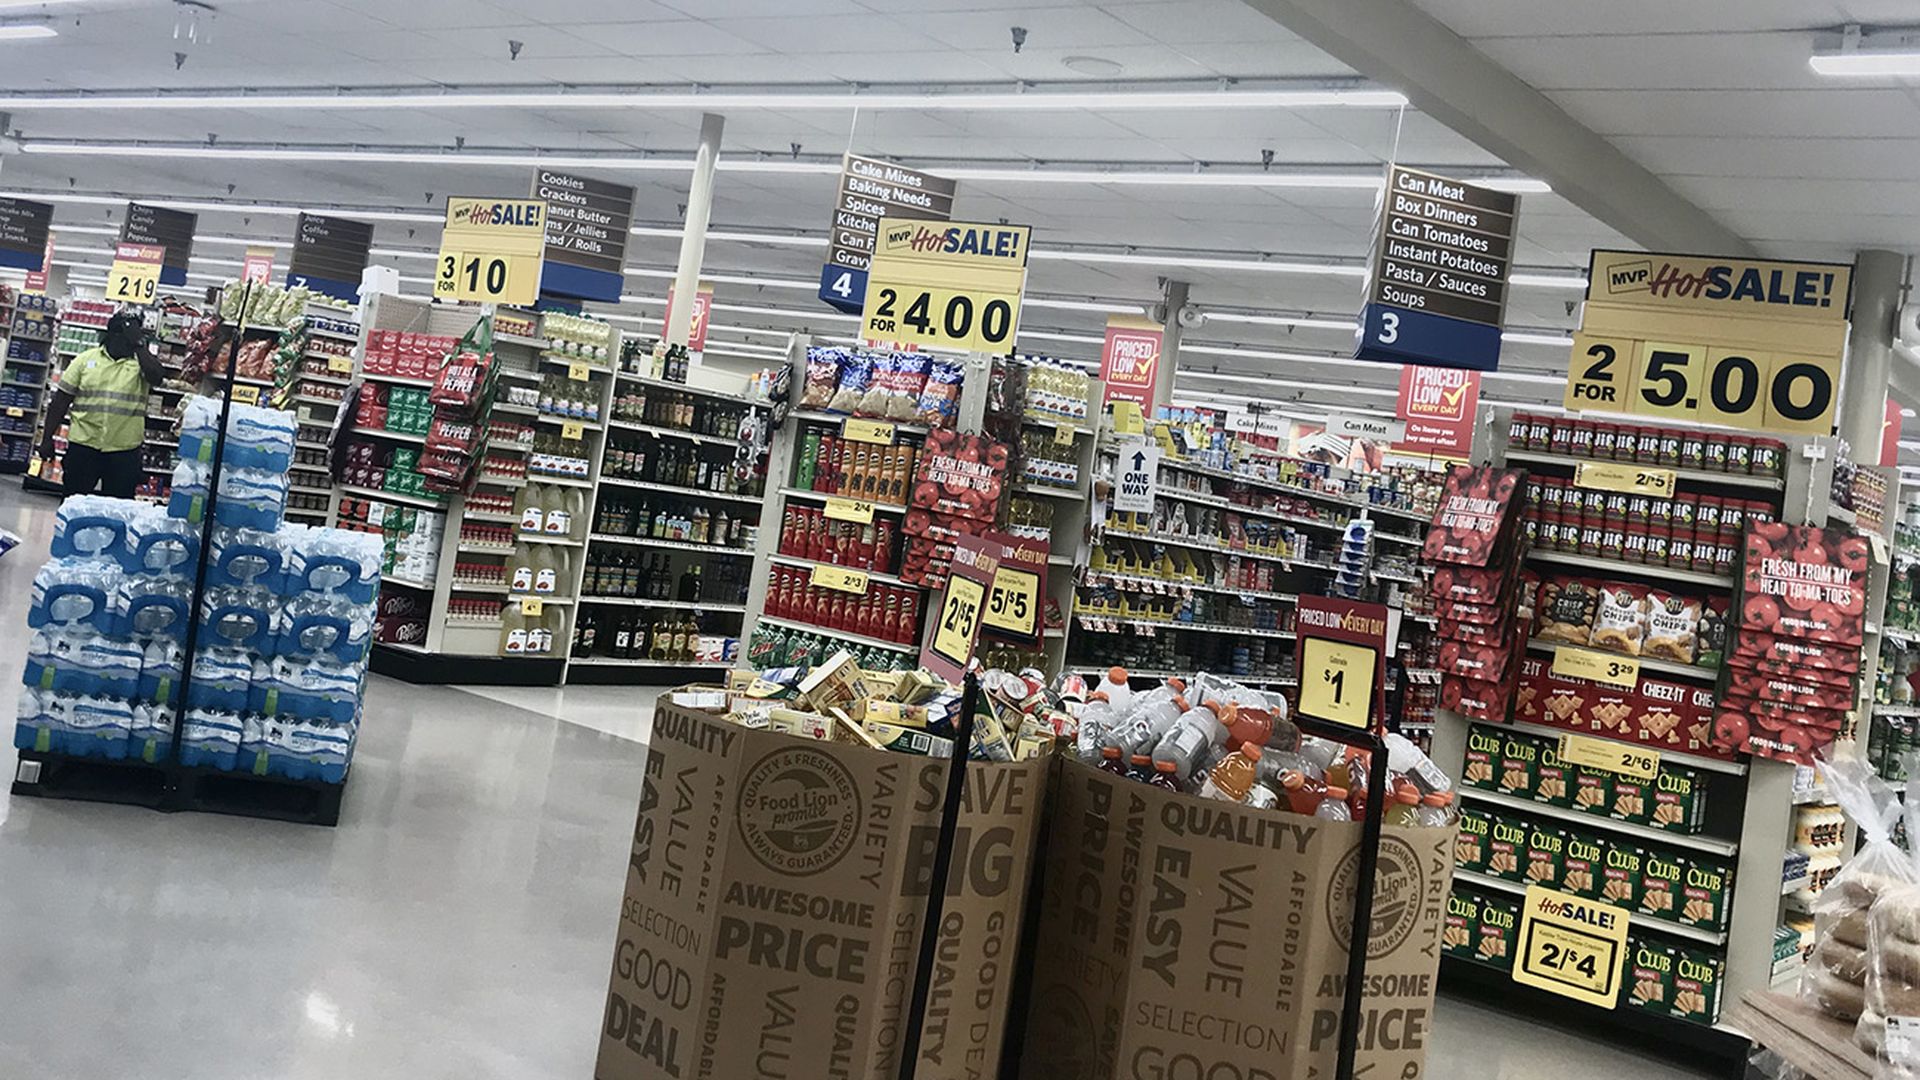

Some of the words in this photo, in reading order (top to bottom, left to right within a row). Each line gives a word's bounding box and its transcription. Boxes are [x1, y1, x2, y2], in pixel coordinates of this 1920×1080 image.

[541, 172, 584, 190] Cookies
[852, 160, 883, 179] Cake
[885, 168, 922, 187] Mixes
[539, 188, 587, 205] Crackers
[849, 178, 891, 201] Baking
[893, 189, 932, 208] Needs
[1398, 174, 1425, 193] Can
[1428, 179, 1465, 201] Meat
[576, 208, 611, 225] Butter
[845, 196, 886, 216] Spices
[1395, 195, 1420, 215] Box
[1424, 202, 1478, 227] Dinners
[129, 223, 147, 232] Nuts
[131, 214, 155, 225] Candy
[302, 225, 329, 236] Coffee
[573, 223, 608, 240] Jellies
[127, 232, 157, 243] Popcorn
[301, 234, 316, 244] Tea
[575, 236, 602, 253] Rolls
[840, 231, 861, 248] Can
[889, 231, 911, 243] MVP
[1391, 218, 1419, 238] Can
[1423, 223, 1488, 252] Tomatoes
[836, 250, 871, 271] Gravy
[1389, 240, 1437, 265] Instant
[1440, 250, 1498, 277] Potatoes
[438, 281, 456, 292] FOR
[442, 255, 456, 279] 3
[465, 257, 507, 294] 10
[832, 272, 852, 298] 4
[1385, 262, 1425, 285] Pasta
[1425, 271, 1437, 287] /
[1439, 273, 1487, 297] Sauces
[1612, 269, 1648, 286] MVP
[1383, 286, 1425, 309] Soups
[870, 319, 896, 333] FOR
[876, 288, 898, 317] 2
[903, 292, 1012, 343] 4.00
[1378, 312, 1399, 344] 3
[1115, 340, 1152, 359] PRICED
[448, 365, 461, 376] HOT
[1111, 372, 1131, 381] EVERY
[1132, 375, 1148, 383] DAY
[1112, 357, 1136, 373] LOW
[1416, 367, 1463, 388] PRICED
[441, 379, 475, 393] PEPPER
[1414, 385, 1442, 404] LOW
[1573, 383, 1616, 402] FOR
[1582, 344, 1617, 382] 2
[1640, 350, 1833, 421] 5.00
[1412, 403, 1438, 413] EVERY
[1439, 405, 1458, 415] DAY
[440, 423, 472, 440] PEPPER
[1236, 418, 1254, 430] Cake
[1257, 420, 1278, 432] Mixes
[1344, 420, 1360, 431] Can
[1362, 421, 1387, 435] Meat
[1406, 433, 1418, 443] buy
[1419, 435, 1435, 443] most
[1411, 424, 1421, 432] On
[1421, 425, 1437, 434] items
[1439, 428, 1454, 436] you
[931, 455, 955, 470] FRESH
[1121, 483, 1150, 496] WAY
[1124, 472, 1149, 485] ONE
[1761, 557, 1797, 578] FRESH
[1800, 563, 1832, 583] FROM
[1833, 568, 1853, 586] MY
[1557, 598, 1583, 609] CRISP
[1615, 592, 1632, 607] RITZ
[1760, 578, 1787, 597] HEAD
[1789, 581, 1852, 606] TO-MA-TOES
[1603, 610, 1635, 624] CHIPS
[1665, 598, 1684, 614] RITZ
[1300, 608, 1325, 626] PRICED
[1325, 612, 1341, 630] LOW
[1348, 616, 1369, 634] EVERY
[1371, 619, 1385, 636] DAY
[1653, 617, 1687, 632] CHIPS
[1324, 668, 1344, 704] $1
[654, 706, 736, 758] QUALITY
[1469, 733, 1500, 753] CLUB
[1505, 741, 1536, 761] CLUB
[1658, 773, 1691, 794] CLUB
[744, 759, 781, 809] QUALITY
[783, 755, 792, 767] &
[795, 754, 853, 801] FRESHNESS
[760, 792, 799, 811] Food
[804, 791, 838, 808] Lion
[630, 749, 666, 885] EASY
[860, 763, 898, 891] VARIETY
[1160, 801, 1317, 855] QUALITY
[660, 766, 698, 897] VALUE
[696, 774, 726, 915] AFFORDABLE
[746, 823, 785, 865] ALWAYS
[1071, 778, 1113, 945] PRICE
[1460, 815, 1488, 835] CLUB
[1494, 824, 1524, 844] CLUB
[1531, 832, 1562, 852] CLUB
[1568, 841, 1600, 862] CLUB
[1607, 849, 1639, 871] CLUB
[1647, 859, 1680, 880] CLUB
[1687, 868, 1721, 891] CLUB
[1113, 792, 1147, 958] AWESOME
[1380, 876, 1407, 893] Lion
[725, 881, 875, 929] AWESOME
[1421, 839, 1448, 959] VARIETY
[622, 896, 701, 956] SELECTION
[1142, 844, 1192, 989] EASY
[1447, 897, 1477, 918] CLUB
[1482, 907, 1514, 929] CLUB
[1205, 863, 1257, 999] VALUE
[1276, 870, 1305, 1012] AFFORDABLE
[715, 915, 870, 985] PRICE
[975, 911, 1005, 1010] GOOD
[1540, 943, 1596, 979] 2/$4
[616, 939, 692, 1012] GOOD
[1637, 949, 1671, 972] CLUB
[1679, 959, 1713, 983] CLUB
[874, 911, 916, 1072] SELECTION
[922, 911, 965, 1067] QUALITY
[606, 991, 681, 1079] DEAL
[1136, 1001, 1289, 1055] SELECTION
